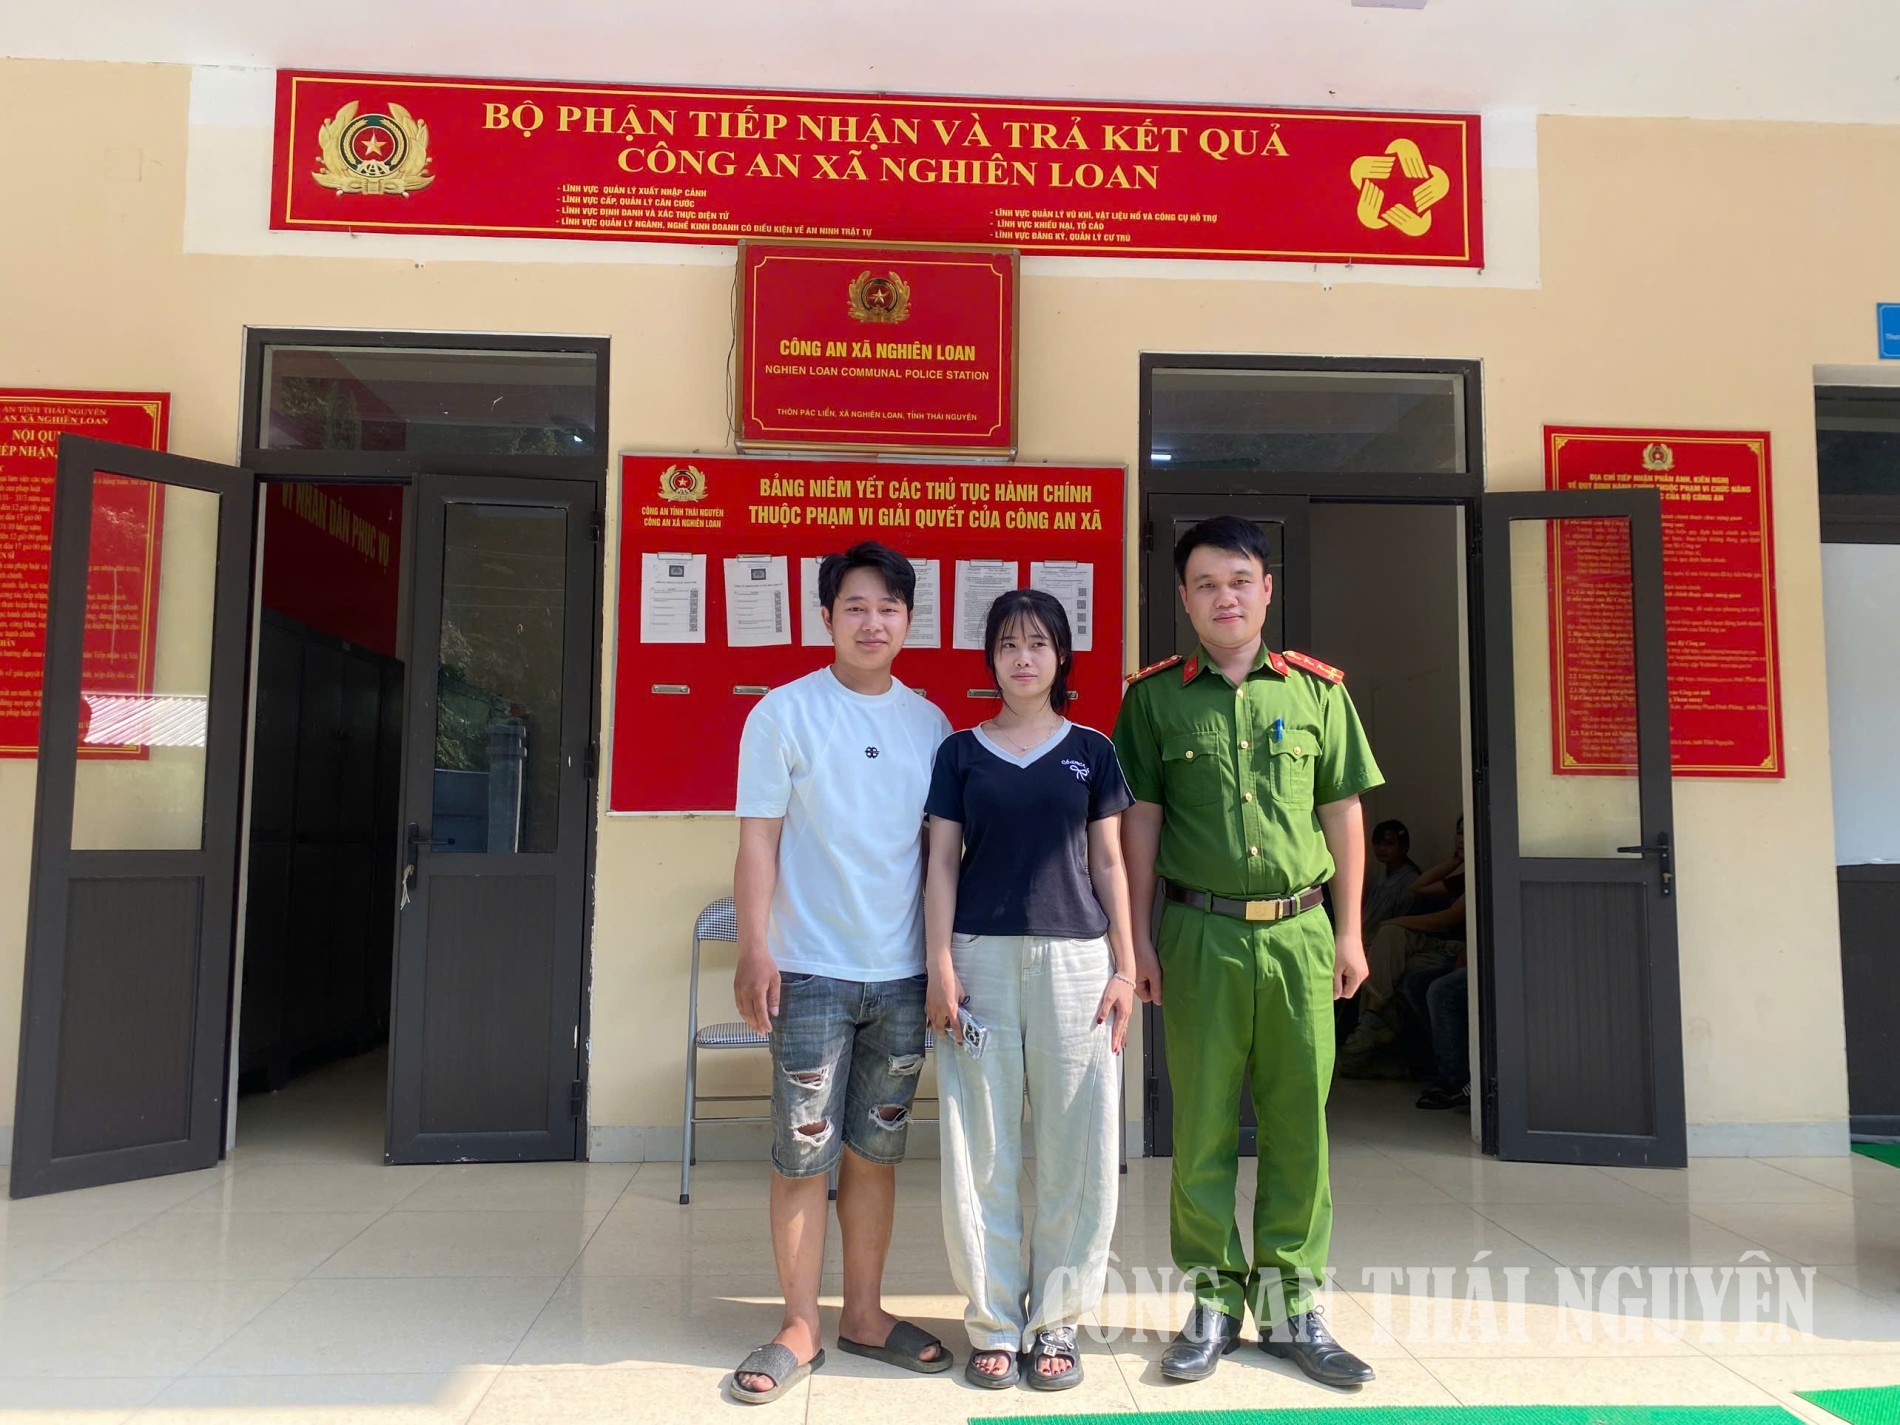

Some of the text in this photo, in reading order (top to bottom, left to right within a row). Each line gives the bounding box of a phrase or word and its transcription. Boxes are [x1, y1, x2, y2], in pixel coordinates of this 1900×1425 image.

[482, 100, 1289, 160] BỘ PHẬN TIẾP NHẬN VÀ TRẢ KẾT QUẢ
[617, 141, 1159, 190] CÔNG AN XÃ NGHIÊN LOAN
[806, 226, 817, 234] AN
[780, 337, 976, 361] CÔNG AN XÃ NGHIÊN LOAN
[765, 364, 989, 380] NGHIEN LOAN COMMUNAL POLICE STATION
[20, 414, 34, 422] XÃ
[67, 407, 107, 415] NGUYÊN
[777, 407, 798, 416] THÔN
[851, 410, 880, 418] NGHIÊN
[906, 410, 924, 420] TỈNH
[927, 411, 944, 420] THÁI
[945, 412, 977, 421] NGUYÊN
[12, 429, 62, 443] NỘI QU
[760, 473, 1092, 505] BẢNG NIÊM YẾT CÁC THỦ TỤC HÀNH CHÍNH
[642, 505, 658, 515] CÔNG
[660, 507, 669, 515] AN
[700, 507, 724, 517] NGUYÊN
[749, 502, 1102, 530] THUỘC PHẠM VI GIẢI QUYẾT CỦA CÔNG AN XÃ
[644, 517, 660, 526] CÔNG
[662, 519, 670, 527] AN
[682, 518, 704, 527] NGHIÊN
[706, 520, 721, 528] LOAN
